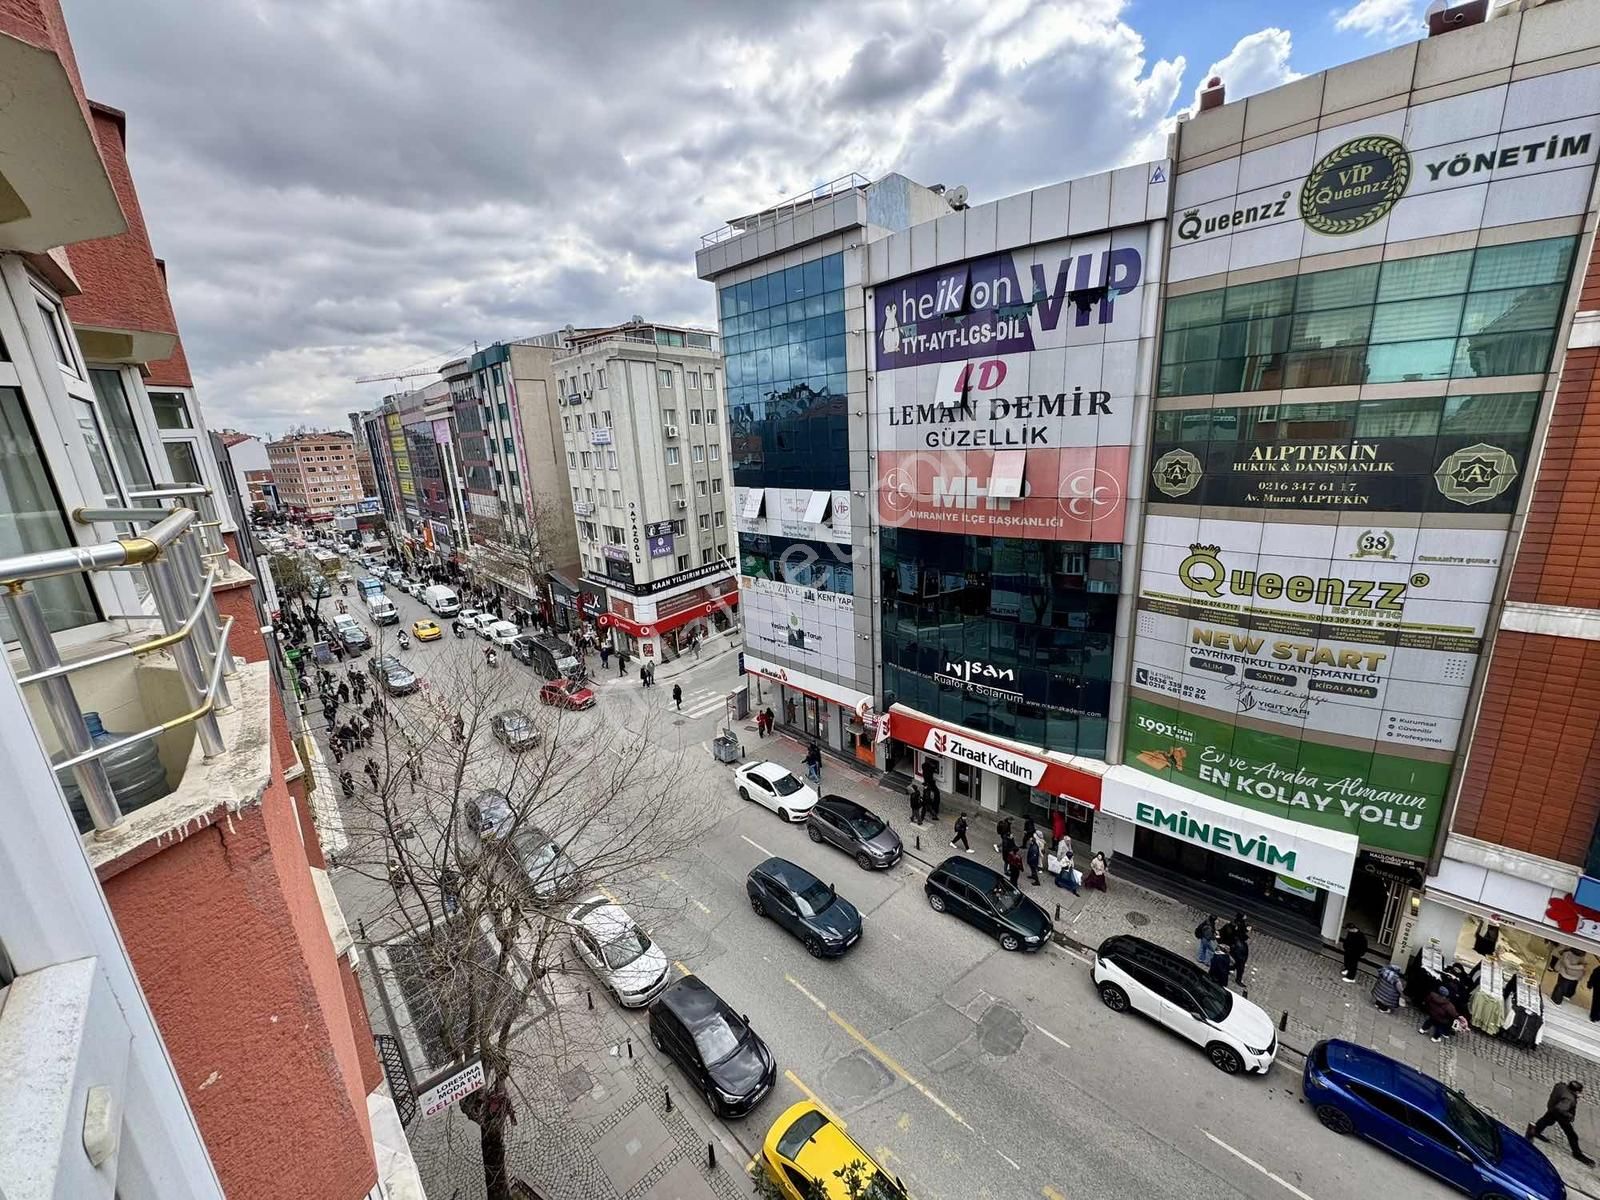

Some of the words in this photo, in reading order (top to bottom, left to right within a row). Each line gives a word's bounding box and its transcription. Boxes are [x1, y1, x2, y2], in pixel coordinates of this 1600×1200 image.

[1426, 133, 1592, 181] YÖNETİM
[1030, 247, 1141, 331] VIP
[902, 318, 1024, 355] TYT-AYT-LGS-DİL
[889, 400, 977, 426] LEMAN
[989, 386, 1112, 421] DEMİR
[926, 424, 1048, 447] GÜZELLİK
[1249, 440, 1379, 461] ALPTEKİN
[1233, 463, 1276, 472] HUKUK
[1280, 463, 1291, 472] &
[1295, 463, 1394, 474] DANIŞMANLIK
[1259, 482, 1288, 491] 0216
[1292, 482, 1315, 491] 347
[1263, 494, 1295, 503] Murat
[1363, 536, 1387, 549] 38
[1192, 627, 1264, 655] NEW
[1271, 642, 1386, 672] START
[1190, 646, 1274, 668] GAYRİMENKUL
[1278, 662, 1381, 684] DANIŞMANLIĞI
[1201, 662, 1223, 672] ALIM
[1256, 672, 1285, 682] SATIM
[1315, 682, 1371, 696] KİRALAMA
[950, 740, 987, 765] Ziraat
[988, 751, 1032, 780] Katılım
[1200, 745, 1226, 770] Ev
[1229, 757, 1248, 773] ve
[1252, 761, 1319, 789] Araba
[1323, 778, 1427, 810] Almanın
[1199, 764, 1230, 787] EN
[1237, 775, 1336, 812] KOLAY
[1340, 800, 1423, 832] YOLU
[1135, 801, 1297, 872] EMİNEVİM
[438, 1081, 466, 1100] MODA
